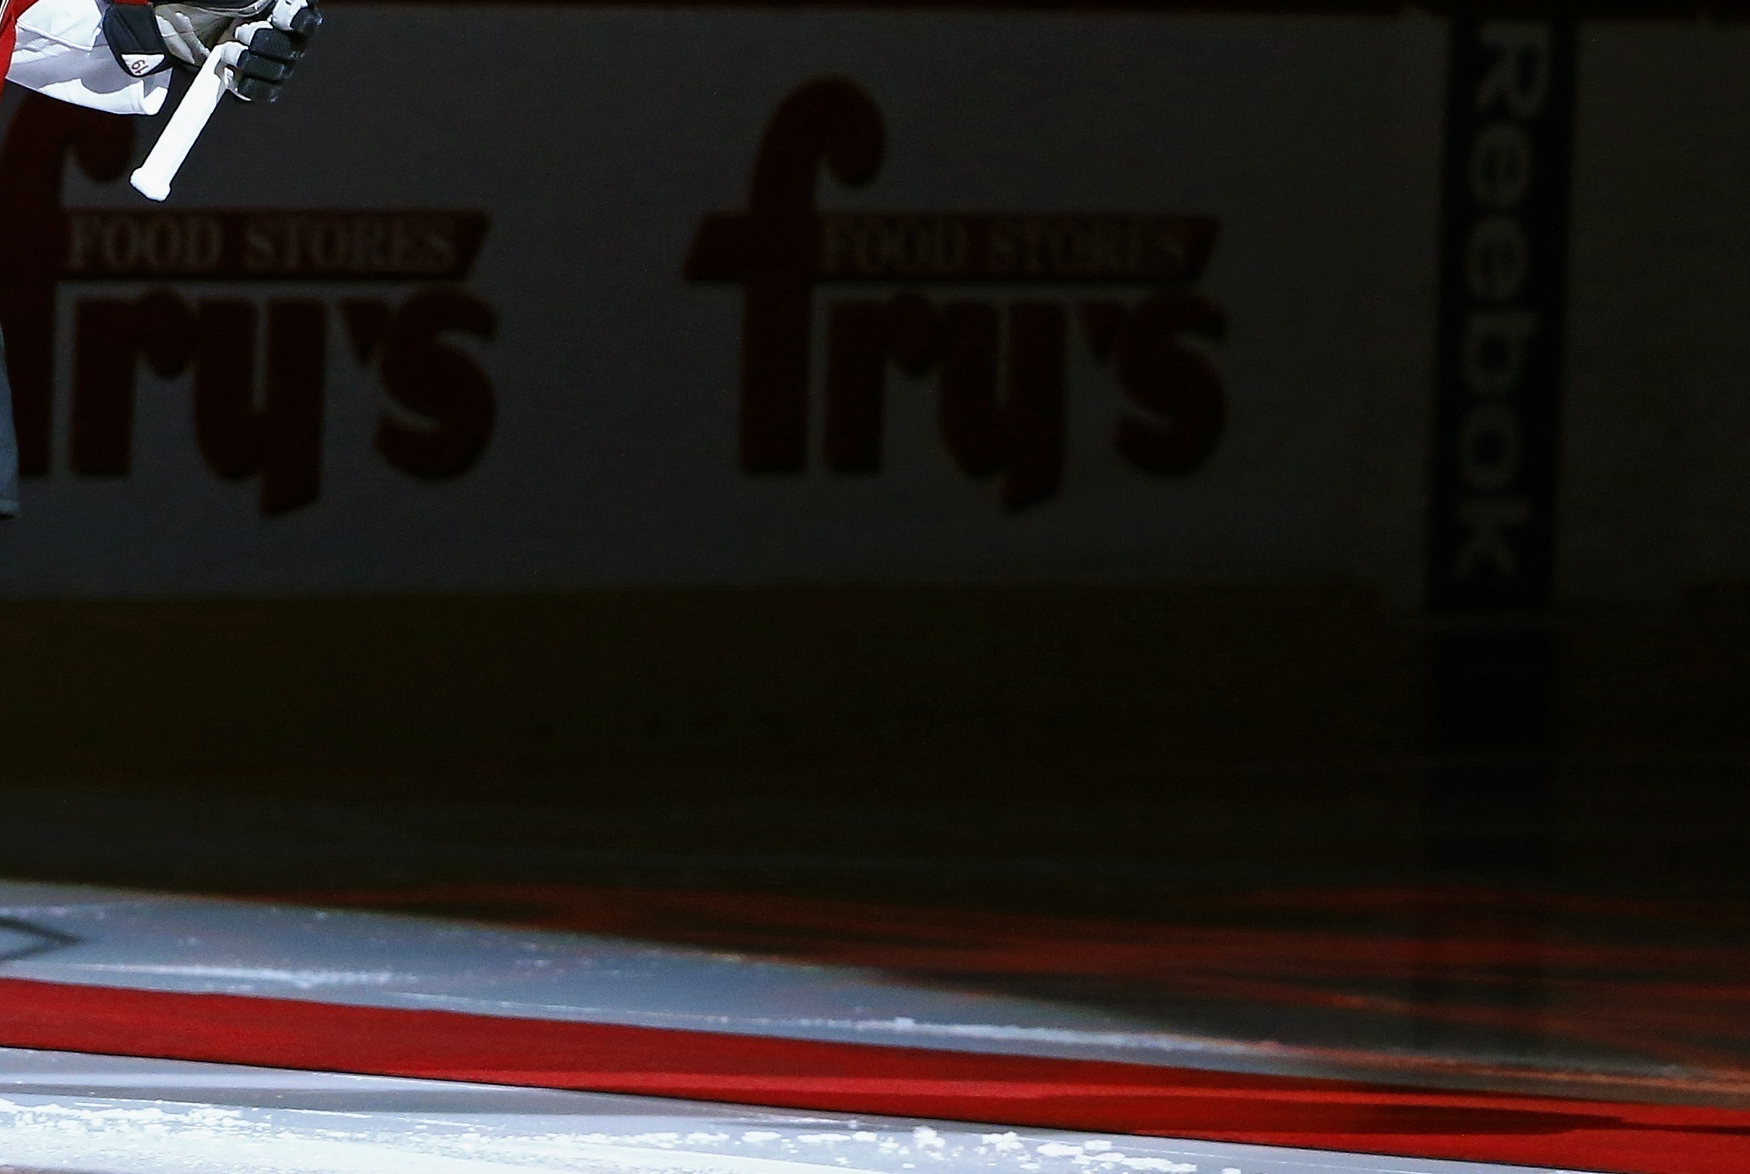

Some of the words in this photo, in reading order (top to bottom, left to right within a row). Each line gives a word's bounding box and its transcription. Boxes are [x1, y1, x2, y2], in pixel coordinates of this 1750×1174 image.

[65, 214, 225, 271] FOOD
[242, 214, 458, 272] STORES
[684, 75, 1228, 512] fry's
[819, 215, 970, 273] FOOD
[986, 217, 1194, 274] STORES
[1451, 23, 1552, 584] Reebok
